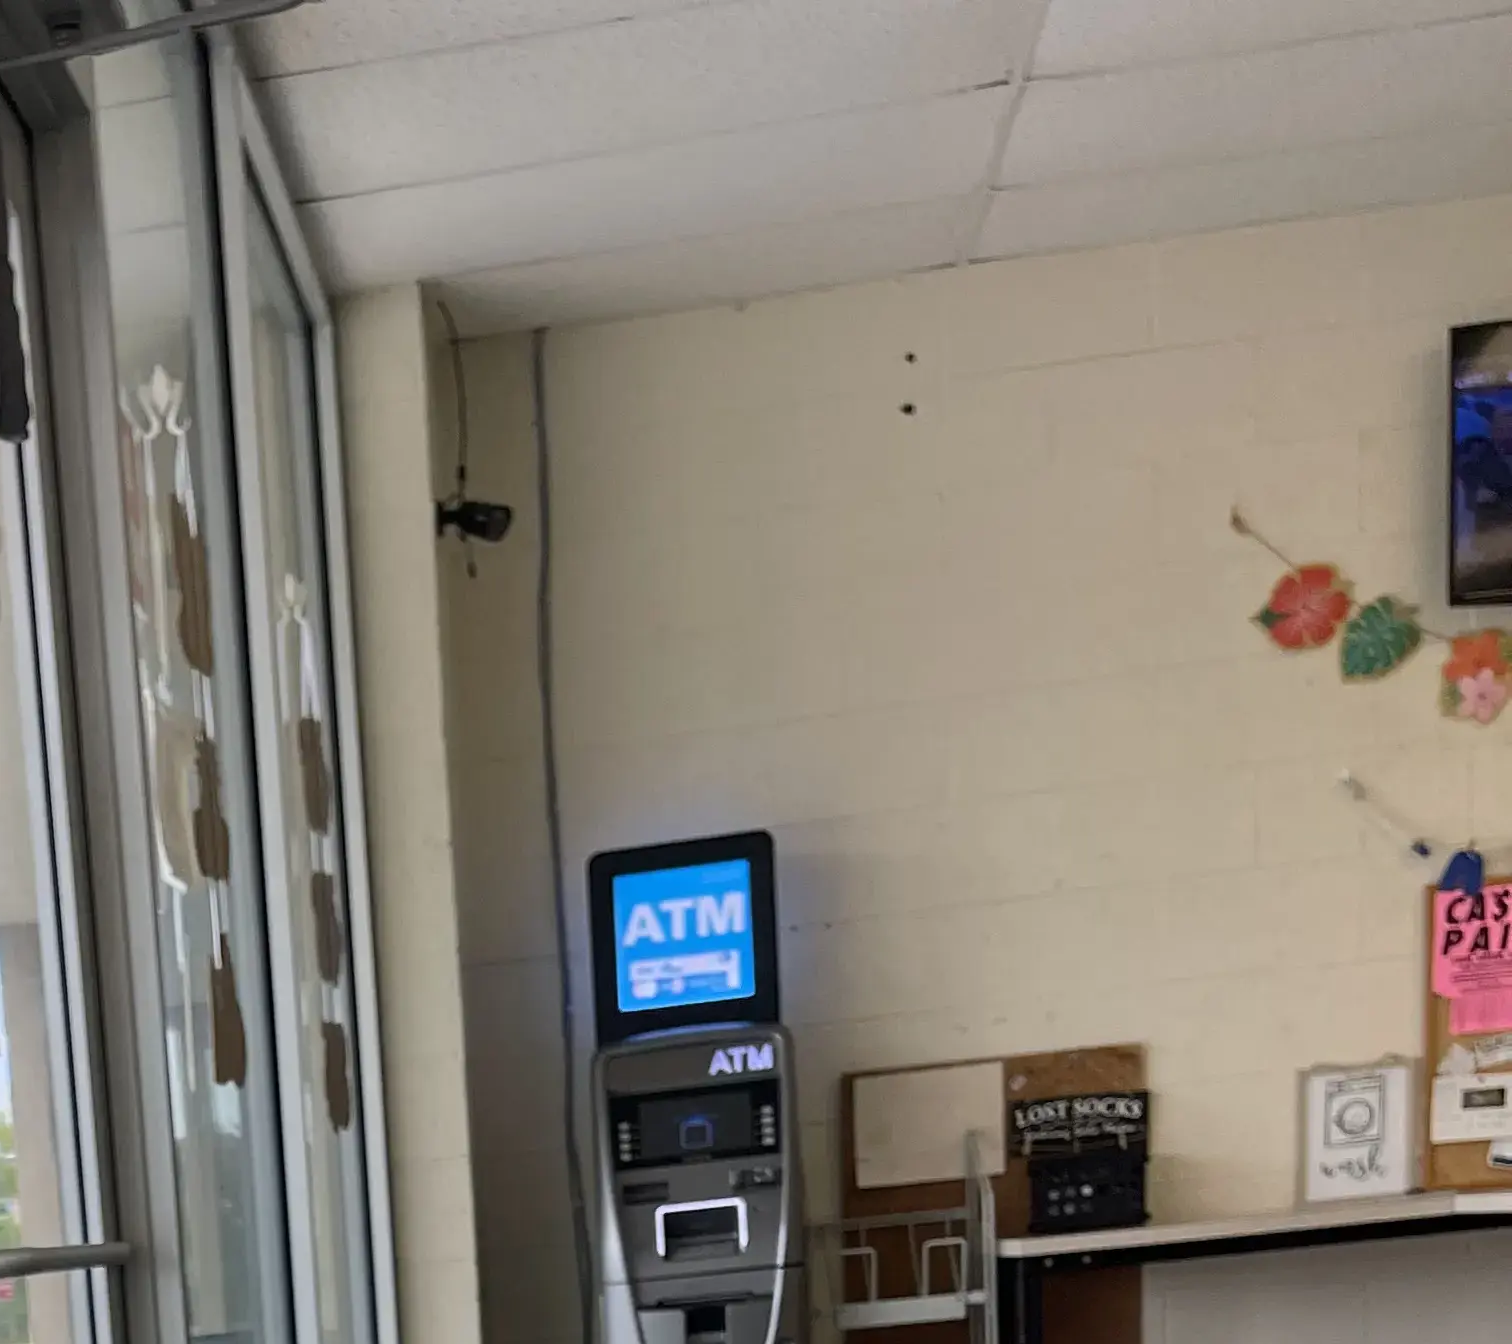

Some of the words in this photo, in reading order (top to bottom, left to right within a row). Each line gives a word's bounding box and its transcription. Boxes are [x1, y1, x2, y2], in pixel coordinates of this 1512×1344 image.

[622, 891, 746, 947] ATM
[707, 1043, 775, 1077] ATM
[1014, 1100, 1069, 1130] LOST
[1071, 1096, 1144, 1120] SOCKS
